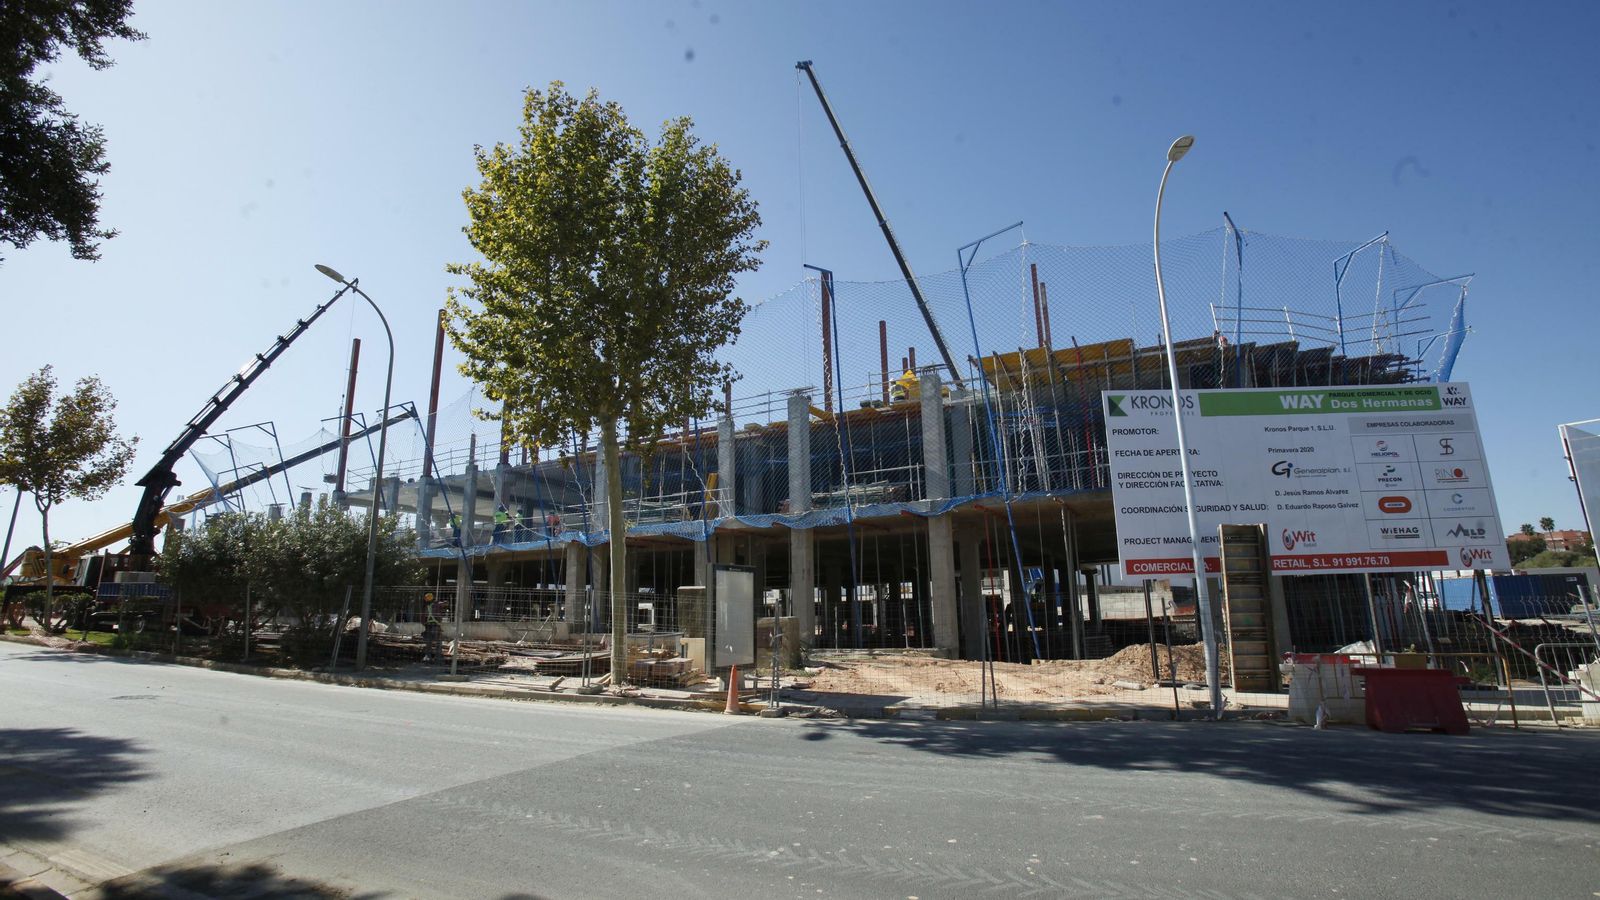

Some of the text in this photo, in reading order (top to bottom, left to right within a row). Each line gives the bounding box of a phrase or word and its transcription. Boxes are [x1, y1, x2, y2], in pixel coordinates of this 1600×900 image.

[1280, 394, 1325, 409] WAY
[1331, 397, 1433, 409] Dos Hermanas
[1442, 397, 1466, 406] WAY
[1112, 428, 1159, 436] PROMOTOR:
[1115, 448, 1200, 457] FECHA DE APERTRA:
[1117, 470, 1160, 479] DIRECCIÓN
[1162, 471, 1173, 479] DE
[1125, 480, 1169, 488] DIRECCIÓN
[1121, 504, 1183, 514] COORDINACIÓN
[1232, 504, 1238, 512] Y
[1240, 503, 1269, 511] SALUD:
[1124, 535, 1219, 545] PROJECT MANAGMENT
[1292, 530, 1316, 543] Wit
[1469, 548, 1492, 560] Wit
[1273, 556, 1390, 568] RETAIL, S.L. 91 991.76.70
